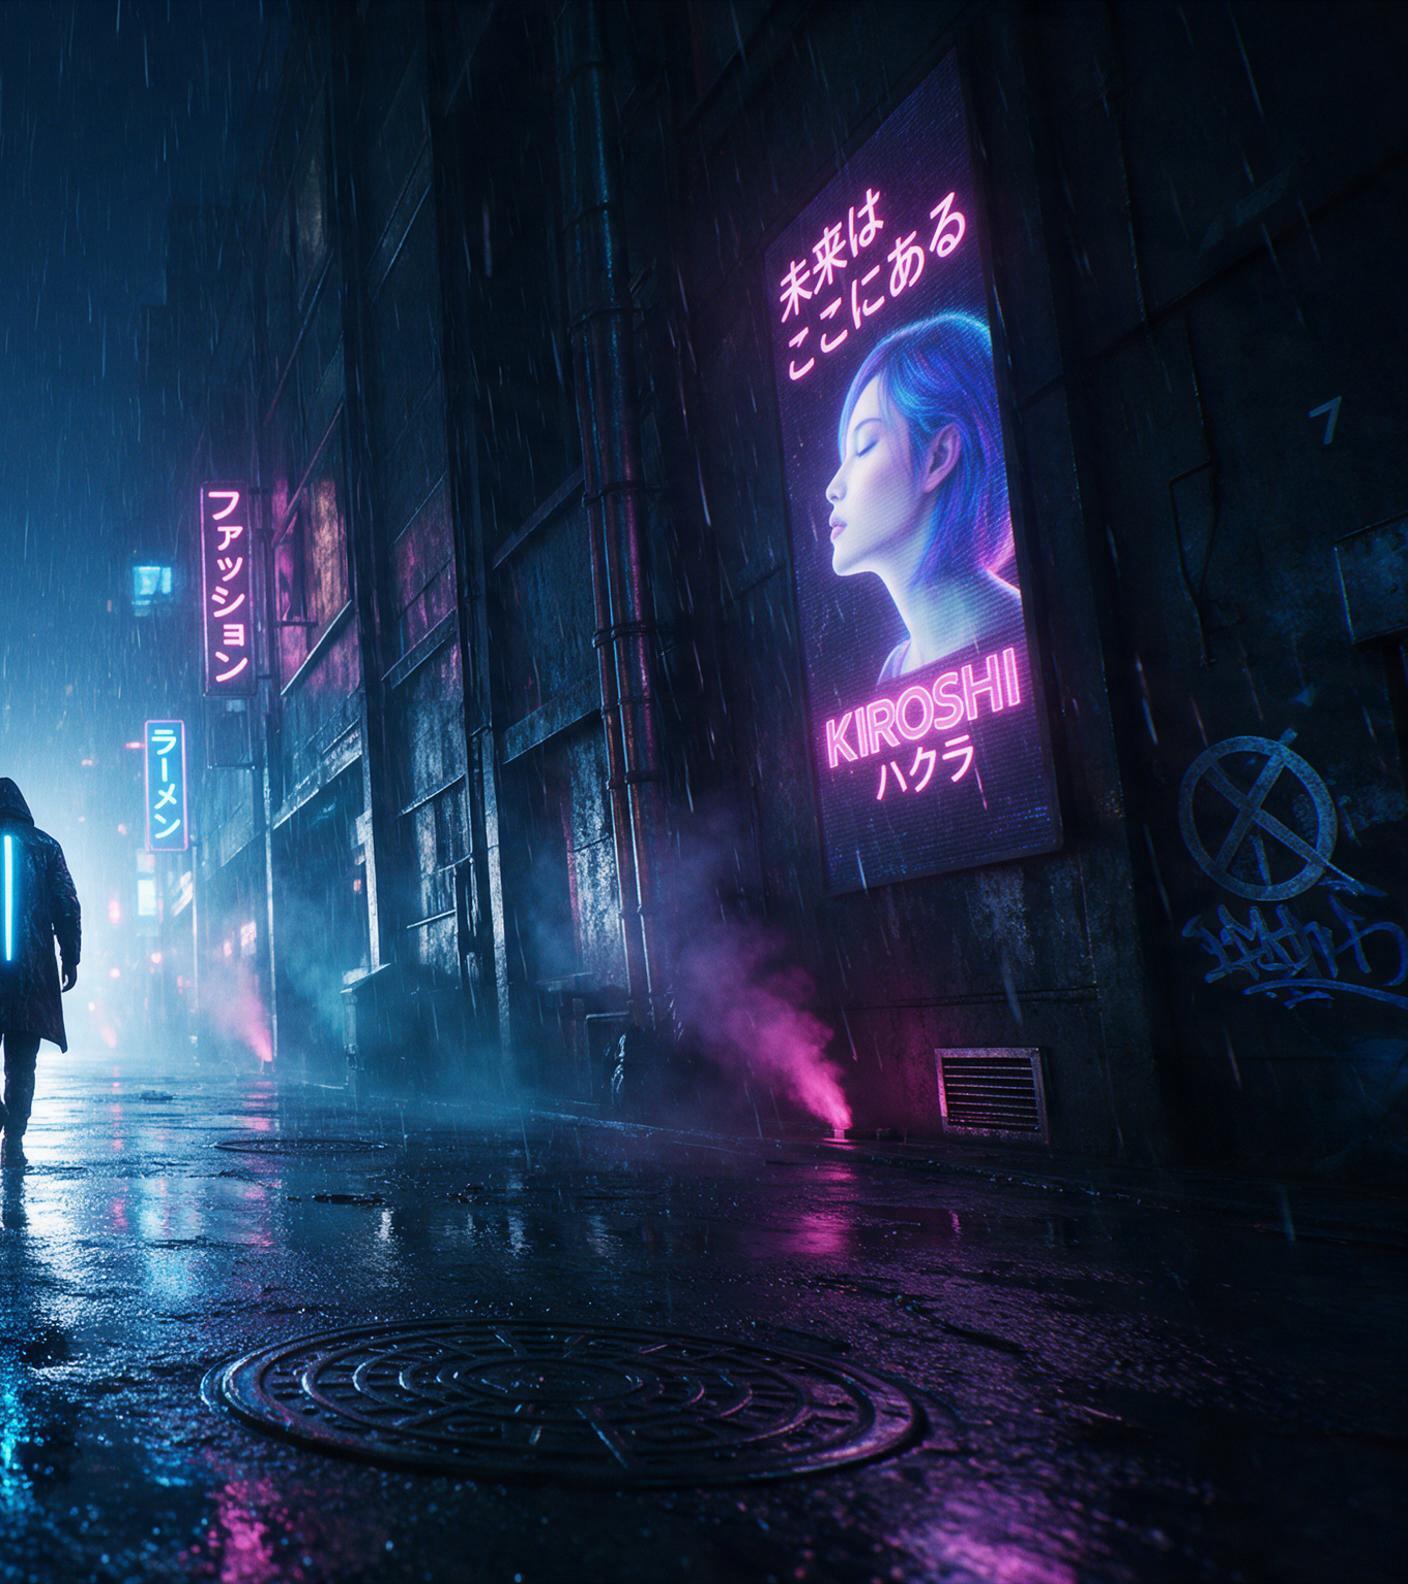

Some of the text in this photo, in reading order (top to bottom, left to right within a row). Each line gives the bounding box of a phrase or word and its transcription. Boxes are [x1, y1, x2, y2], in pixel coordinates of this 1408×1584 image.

[779, 188, 884, 323] 未来は
[788, 191, 966, 381] ここにある
[208, 491, 248, 683] ファッション
[825, 647, 1021, 769] KIROSHI
[876, 734, 974, 800] ハクラ
[151, 729, 181, 839] ラーメン
